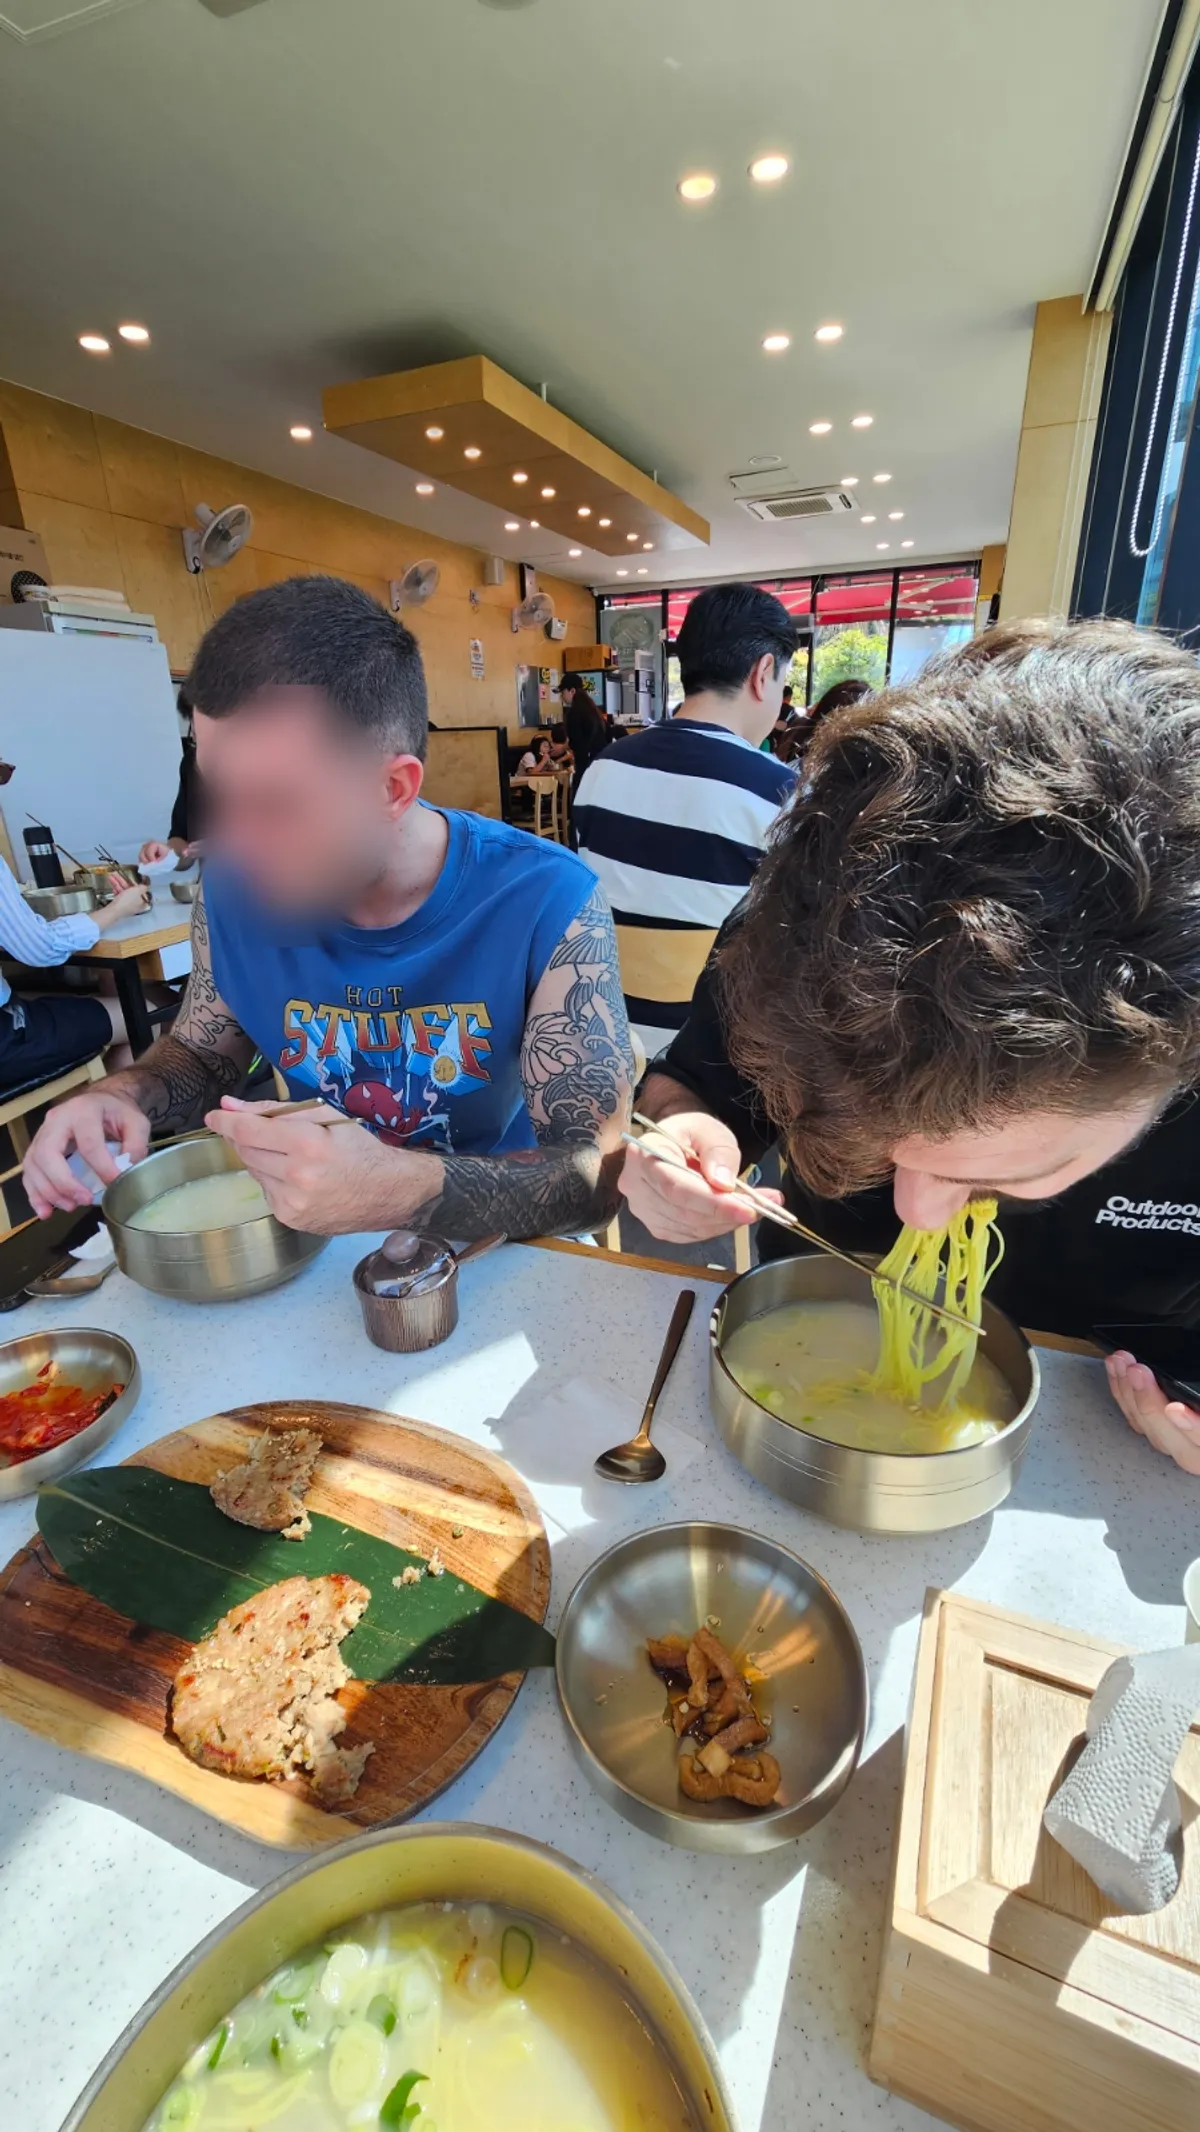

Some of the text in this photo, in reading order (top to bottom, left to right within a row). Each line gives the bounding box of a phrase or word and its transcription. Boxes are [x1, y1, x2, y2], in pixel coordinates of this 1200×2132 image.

[345, 985, 403, 1007] HOT
[279, 999, 493, 1083] STUFF
[1094, 1208, 1200, 1236] Products
